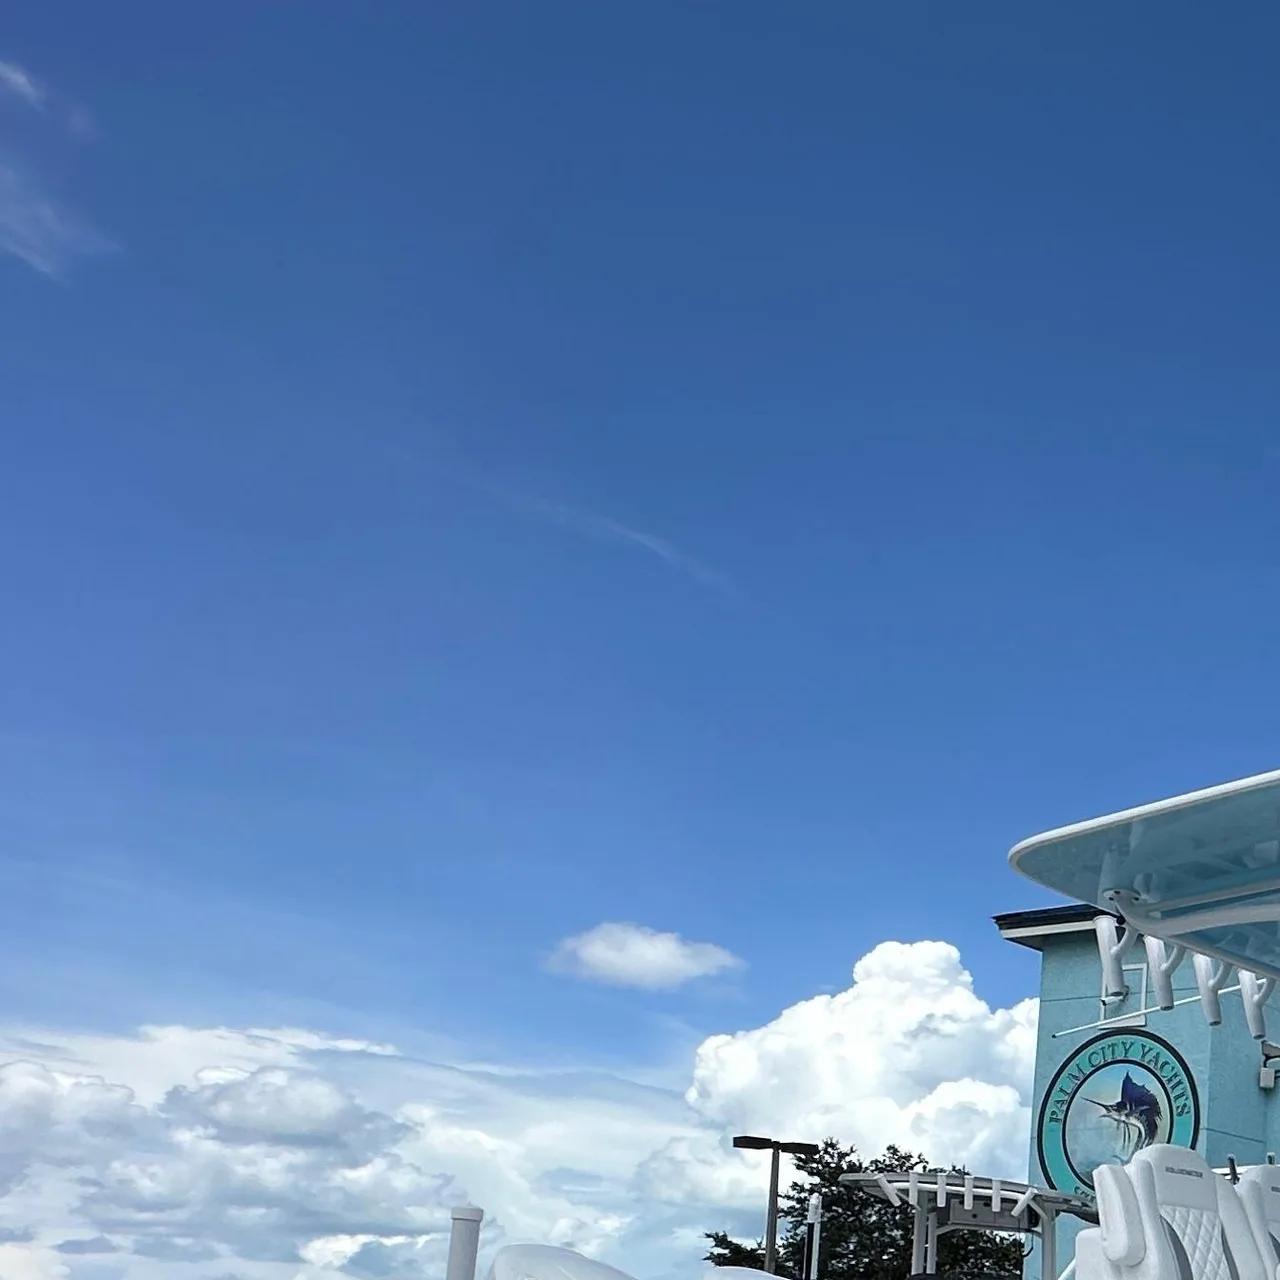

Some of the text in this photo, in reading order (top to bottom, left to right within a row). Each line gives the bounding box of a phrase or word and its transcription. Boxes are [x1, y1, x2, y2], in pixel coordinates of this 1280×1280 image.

[1048, 1041, 1192, 1123] PALM CITY YACHTS
